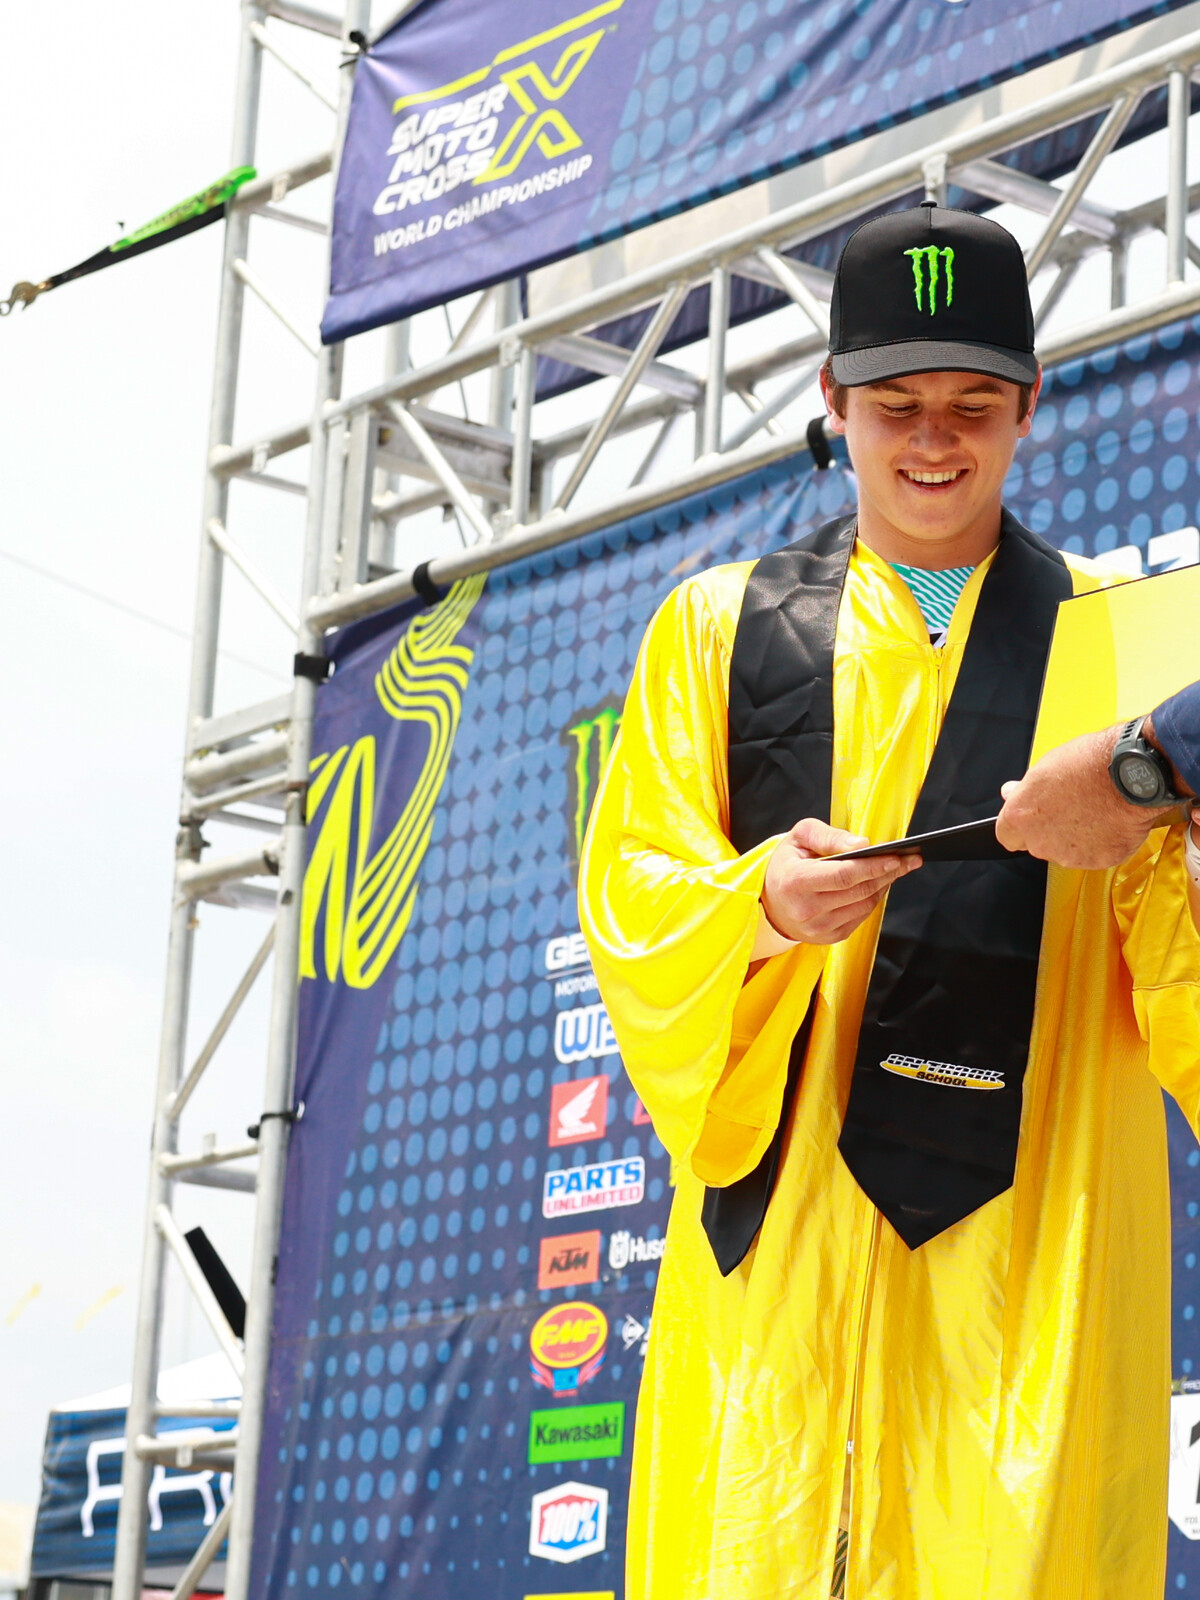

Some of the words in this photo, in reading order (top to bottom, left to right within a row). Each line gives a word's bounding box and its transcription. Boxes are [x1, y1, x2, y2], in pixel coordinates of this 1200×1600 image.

[387, 83, 510, 156] SUPER
[388, 117, 499, 184] MOTO
[372, 148, 497, 216] CROSS
[374, 214, 442, 256] WORLD
[443, 154, 593, 231] CHAMPIONSHIP
[916, 1071, 967, 1087] SCHOOL
[547, 1161, 641, 1197] PARTS
[545, 1186, 641, 1214] UNLIMITED
[549, 1247, 590, 1274] KTM
[538, 1318, 602, 1348] FMF
[535, 1416, 618, 1447] Kawasaki
[541, 1500, 598, 1544] 100%
